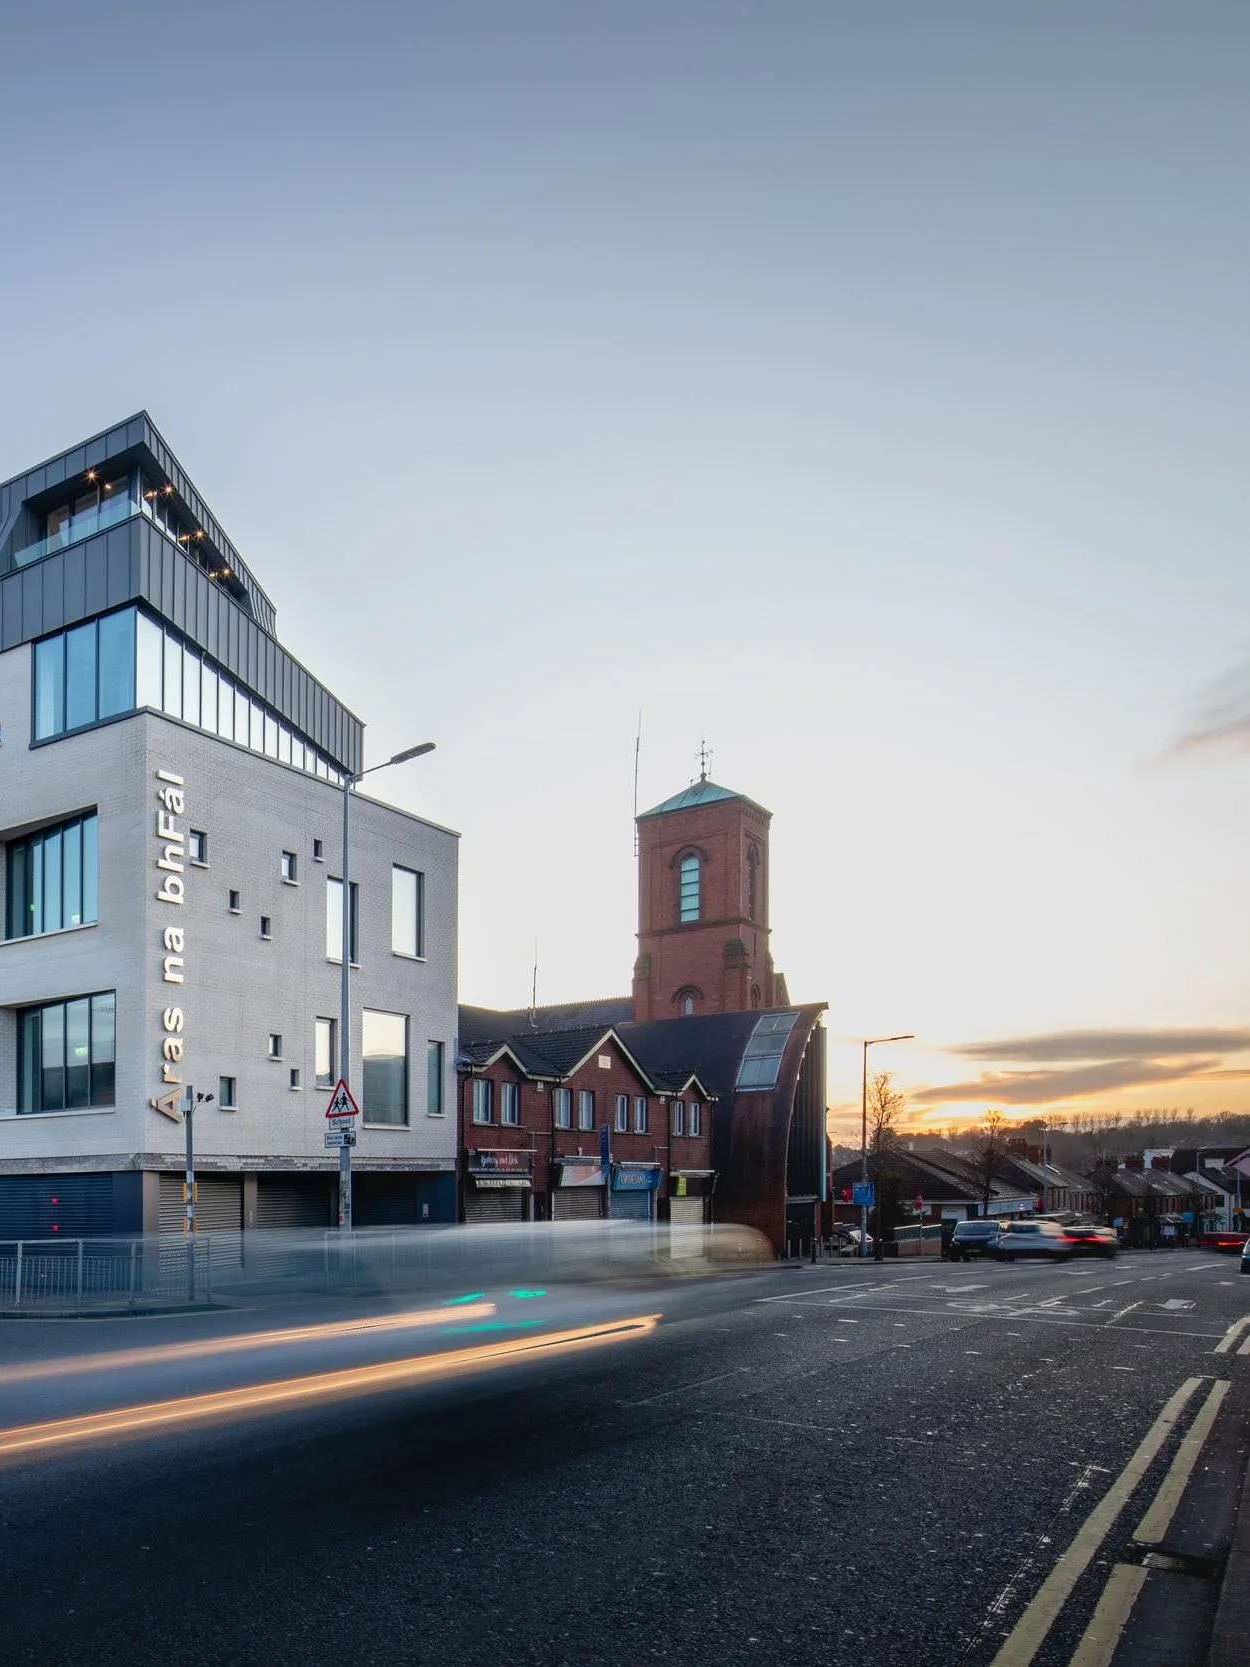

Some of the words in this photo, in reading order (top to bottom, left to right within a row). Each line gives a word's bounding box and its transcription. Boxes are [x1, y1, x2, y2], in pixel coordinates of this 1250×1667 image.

[156, 769, 185, 904] bhFál
[163, 926, 185, 983] na
[150, 1007, 184, 1123] Áras
[332, 1117, 351, 1126] School
[620, 1174, 647, 1186] OPTICIANS
